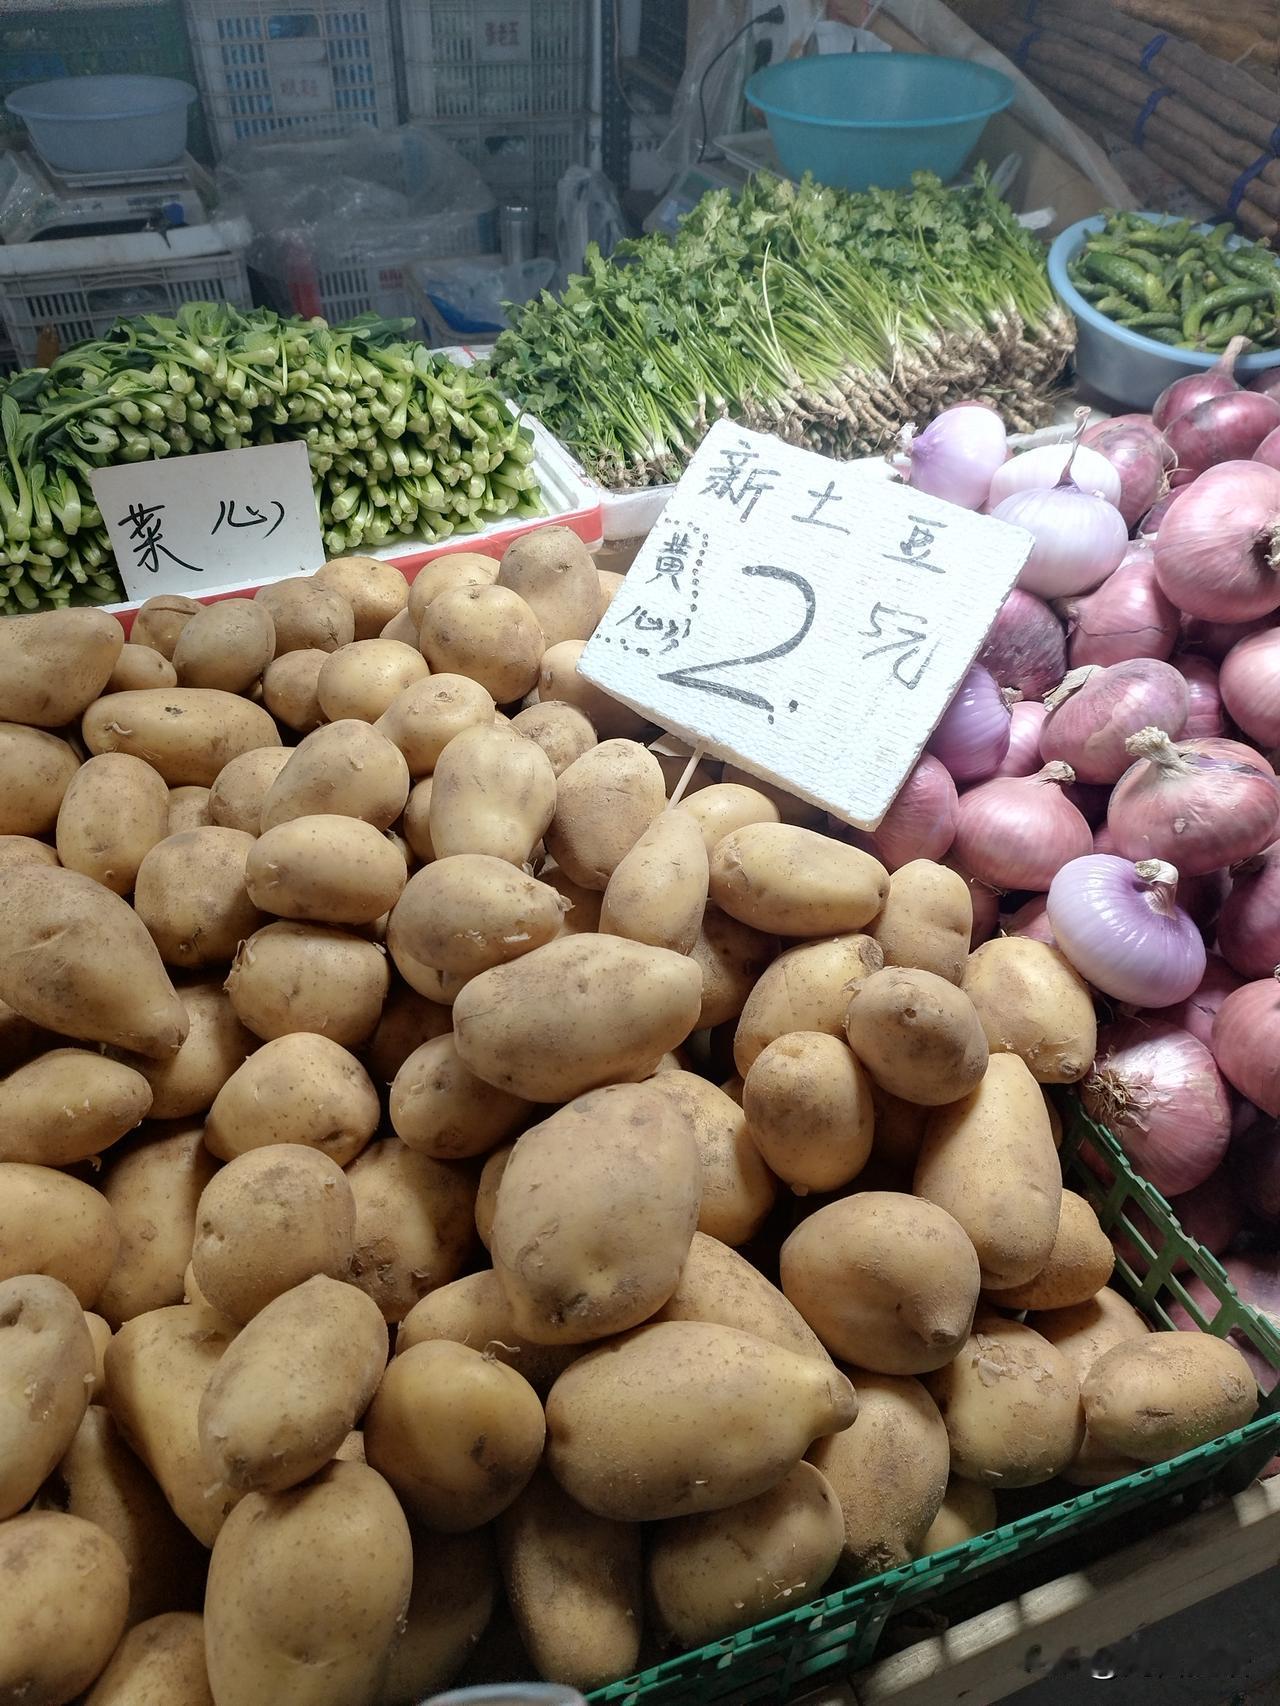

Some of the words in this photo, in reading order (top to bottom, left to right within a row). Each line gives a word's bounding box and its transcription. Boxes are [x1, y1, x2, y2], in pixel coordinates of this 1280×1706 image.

[118, 501, 284, 573] 菜心
[699, 440, 948, 574] 新土豆
